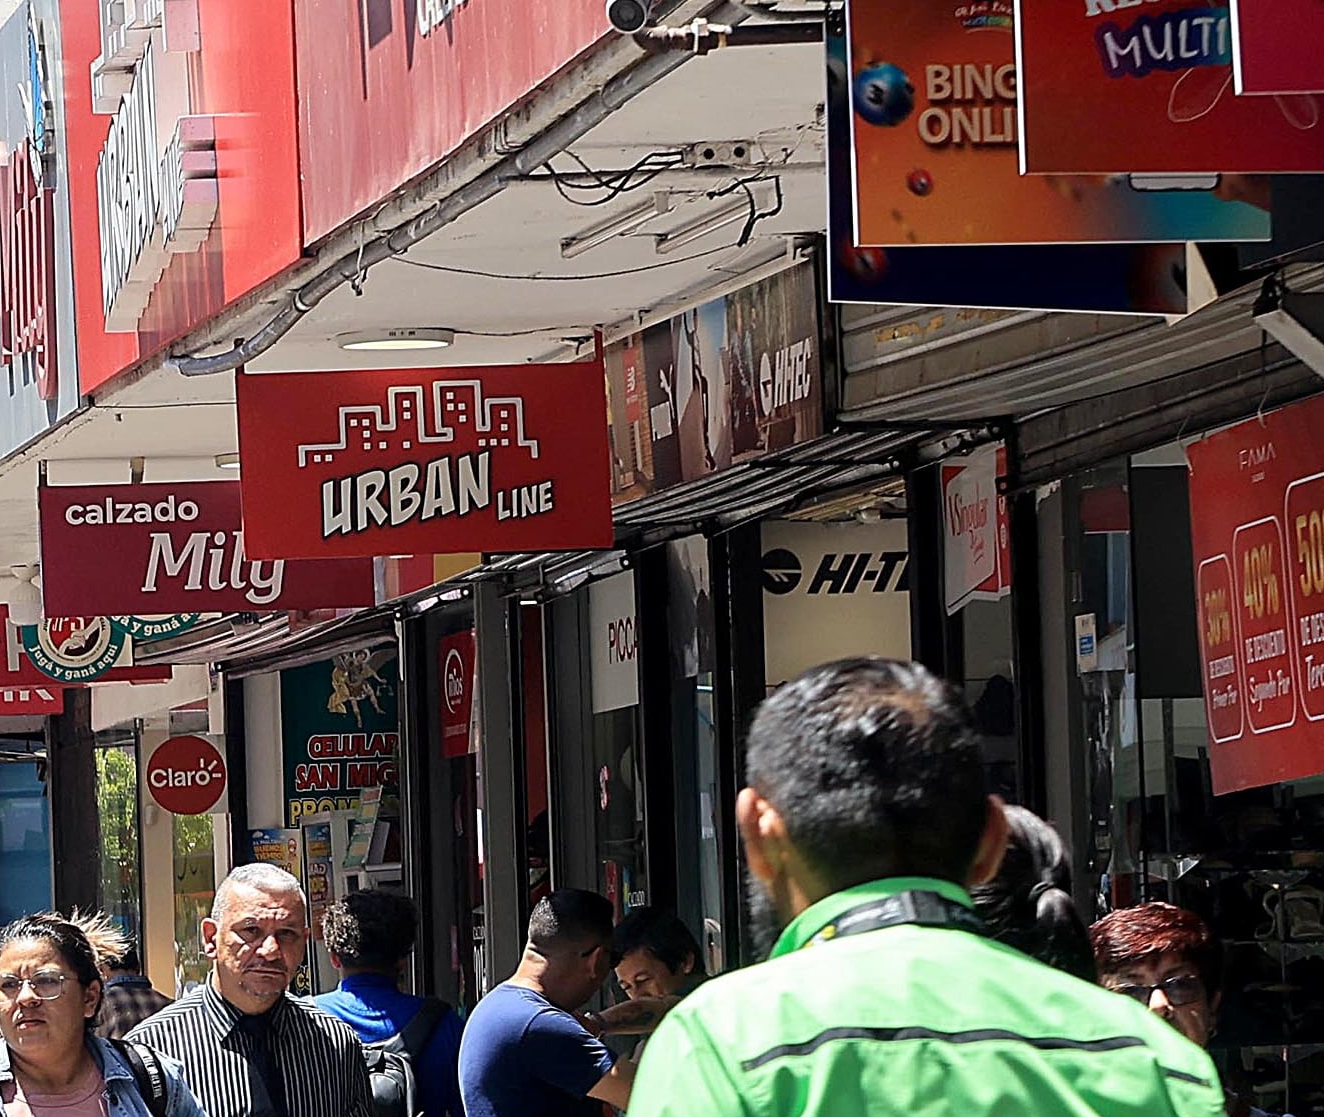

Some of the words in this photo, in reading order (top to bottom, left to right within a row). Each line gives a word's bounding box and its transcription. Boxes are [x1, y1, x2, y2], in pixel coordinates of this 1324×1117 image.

[1104, 17, 1228, 70] MULTI
[1239, 443, 1276, 470] FAMA
[65, 495, 200, 526] calzado
[321, 450, 491, 539] URBAN
[497, 480, 554, 522] LINE
[141, 532, 287, 604] Mily
[1243, 544, 1280, 621] 40%
[144, 616, 180, 636] ganá
[29, 644, 54, 672] Jugá
[64, 665, 97, 681] ganá
[96, 643, 119, 670] aquí
[150, 767, 212, 788] Claro
[296, 763, 340, 792] SAN
